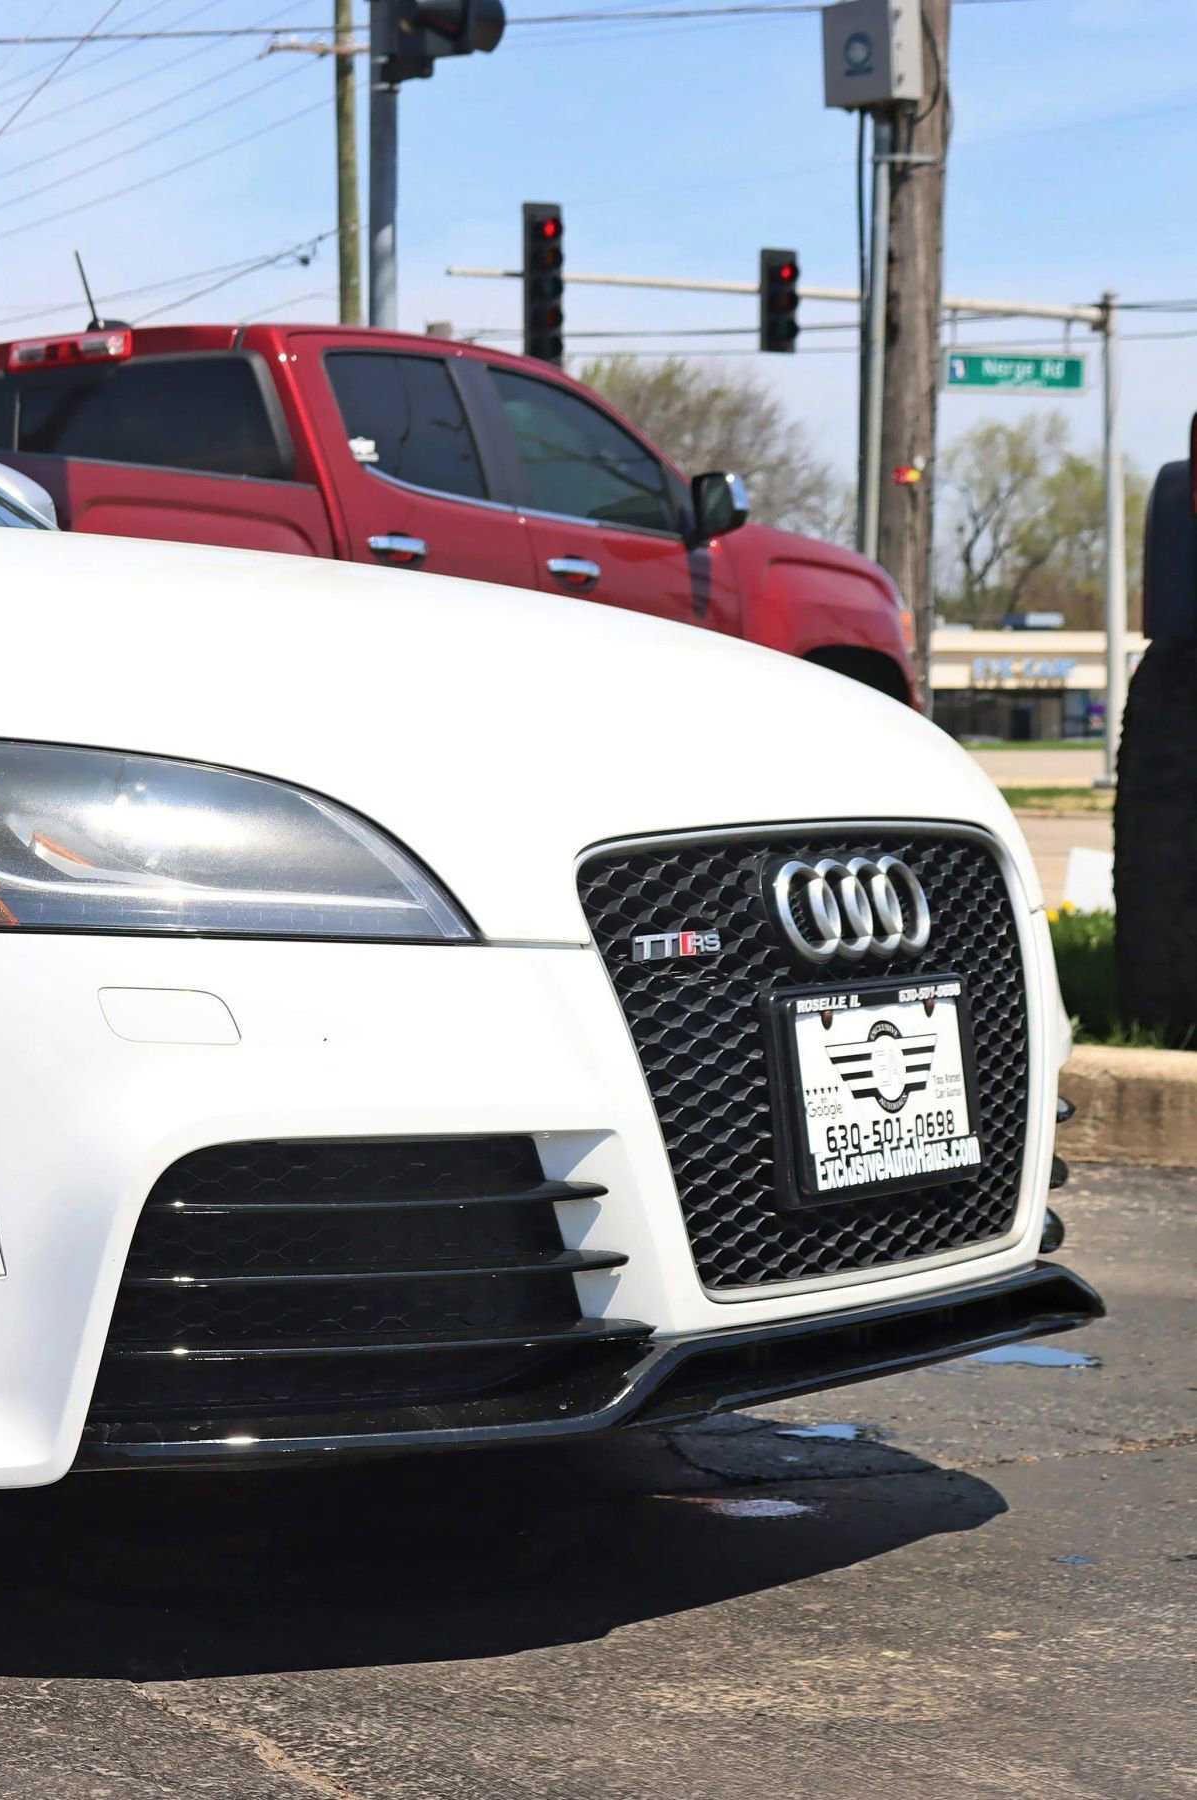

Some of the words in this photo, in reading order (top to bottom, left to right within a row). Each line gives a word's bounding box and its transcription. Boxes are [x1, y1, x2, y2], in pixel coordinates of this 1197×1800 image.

[1041, 360, 1065, 379] Rd
[796, 996, 848, 1013] ROSELLE,
[849, 995, 861, 1008] IL
[807, 1099, 843, 1119] Google
[826, 1109, 954, 1153] 630-501-0698
[814, 1136, 982, 1191] ExclusiveAutoHaus.com
